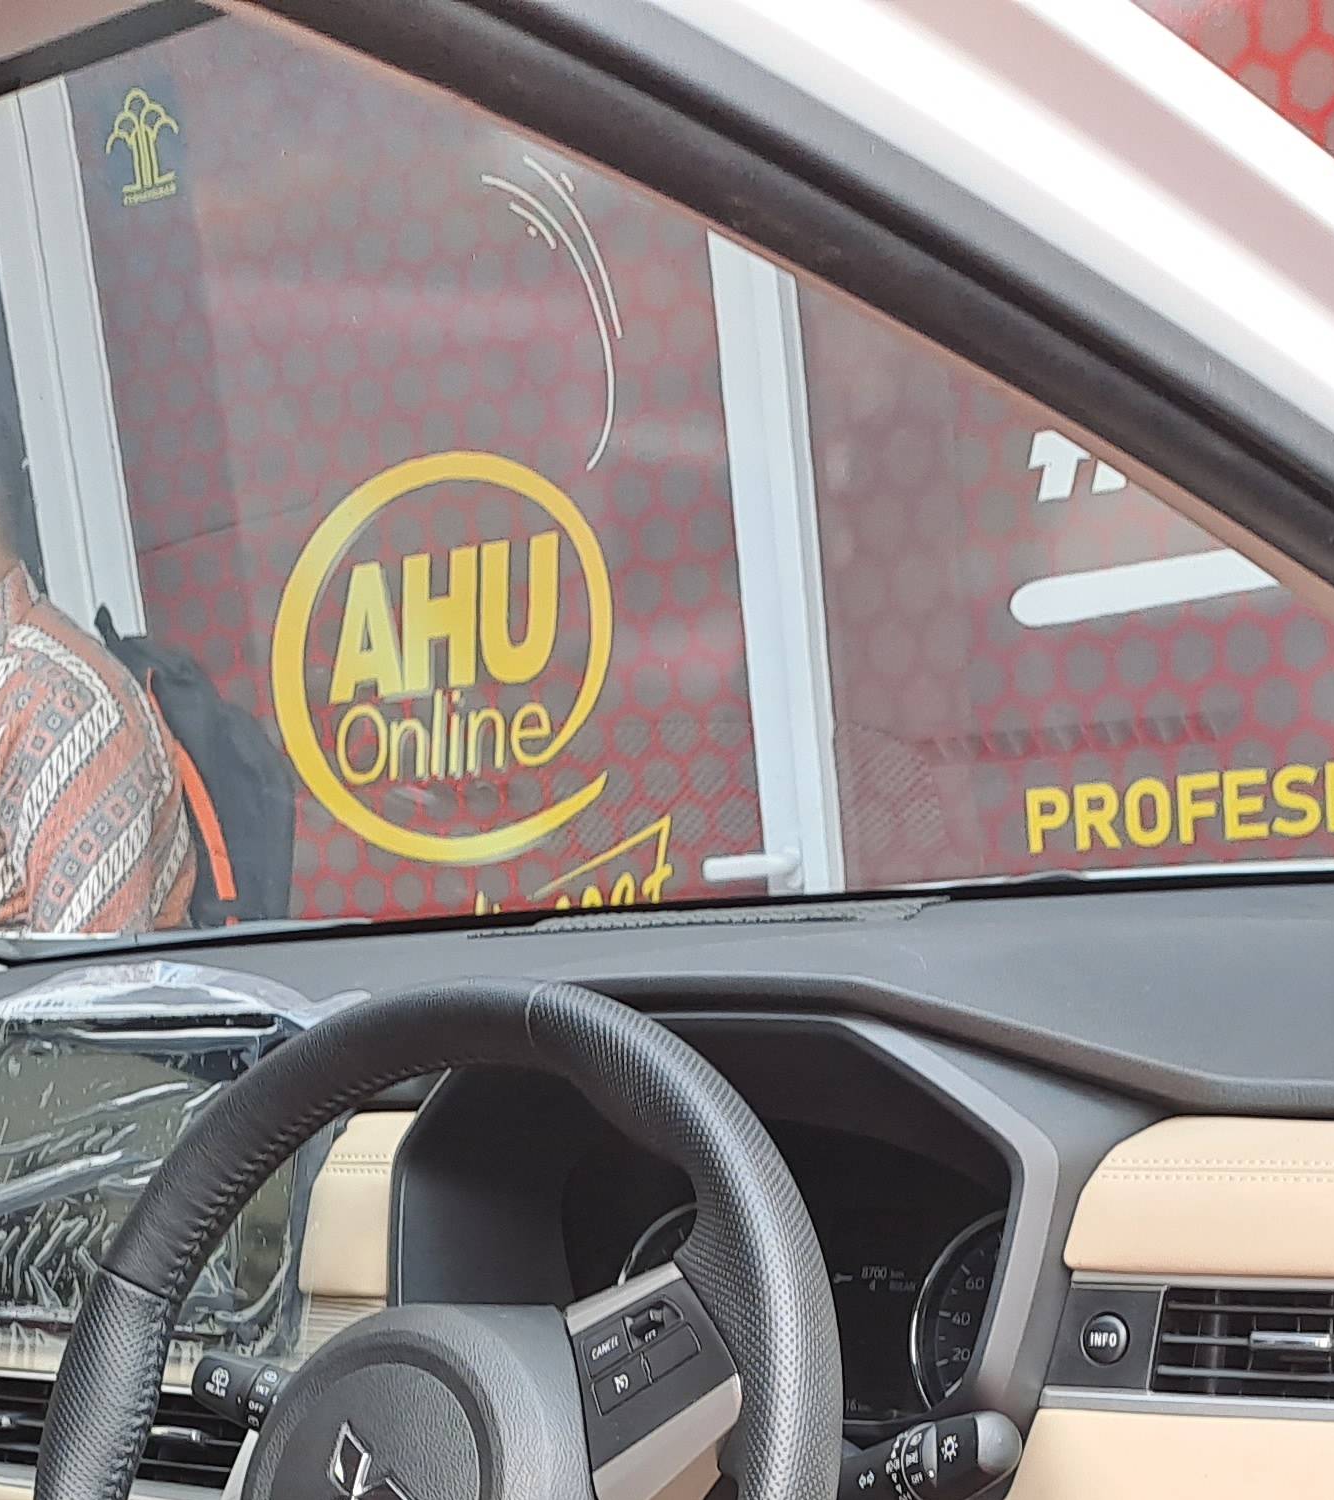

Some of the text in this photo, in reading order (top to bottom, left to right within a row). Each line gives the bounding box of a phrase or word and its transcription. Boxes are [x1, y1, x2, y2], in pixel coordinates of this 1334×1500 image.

[328, 530, 560, 706] AHU
[335, 688, 552, 787] Online
[967, 1278, 985, 1290] 60
[951, 1312, 971, 1326] 40
[1090, 1331, 1117, 1348] INFO
[952, 1347, 971, 1362] 20
